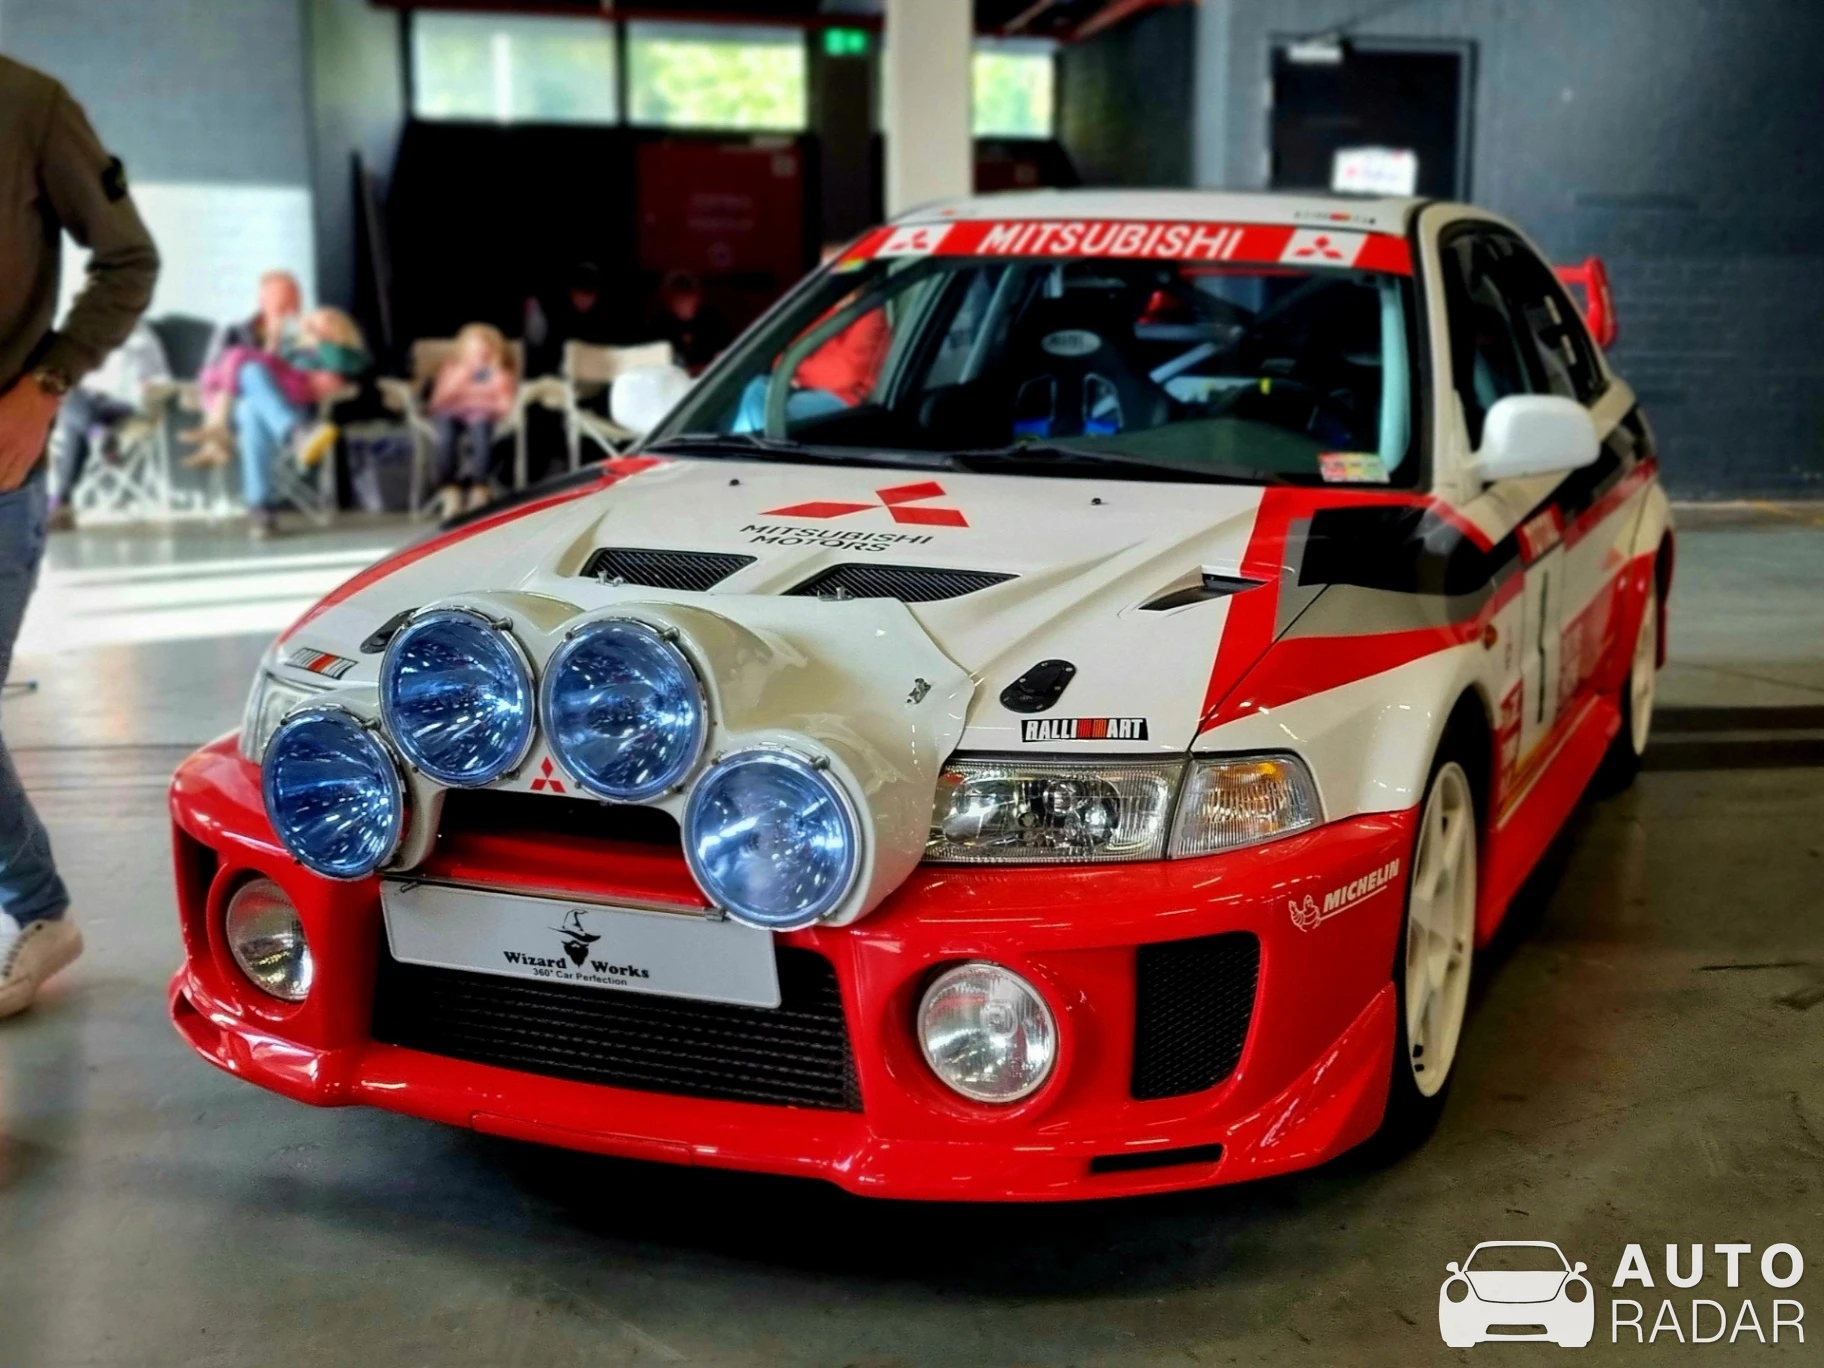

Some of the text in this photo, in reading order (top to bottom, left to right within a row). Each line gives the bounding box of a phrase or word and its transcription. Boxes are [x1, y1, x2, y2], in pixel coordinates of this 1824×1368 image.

[975, 222, 1245, 261] MITSUBISHI
[740, 524, 934, 545] MITSUBISHI
[749, 535, 891, 552] MOTORS
[1322, 857, 1400, 914] MICHELIN
[503, 951, 650, 979] Wizard Works
[556, 970, 574, 980] Car
[576, 972, 628, 986] Perfection
